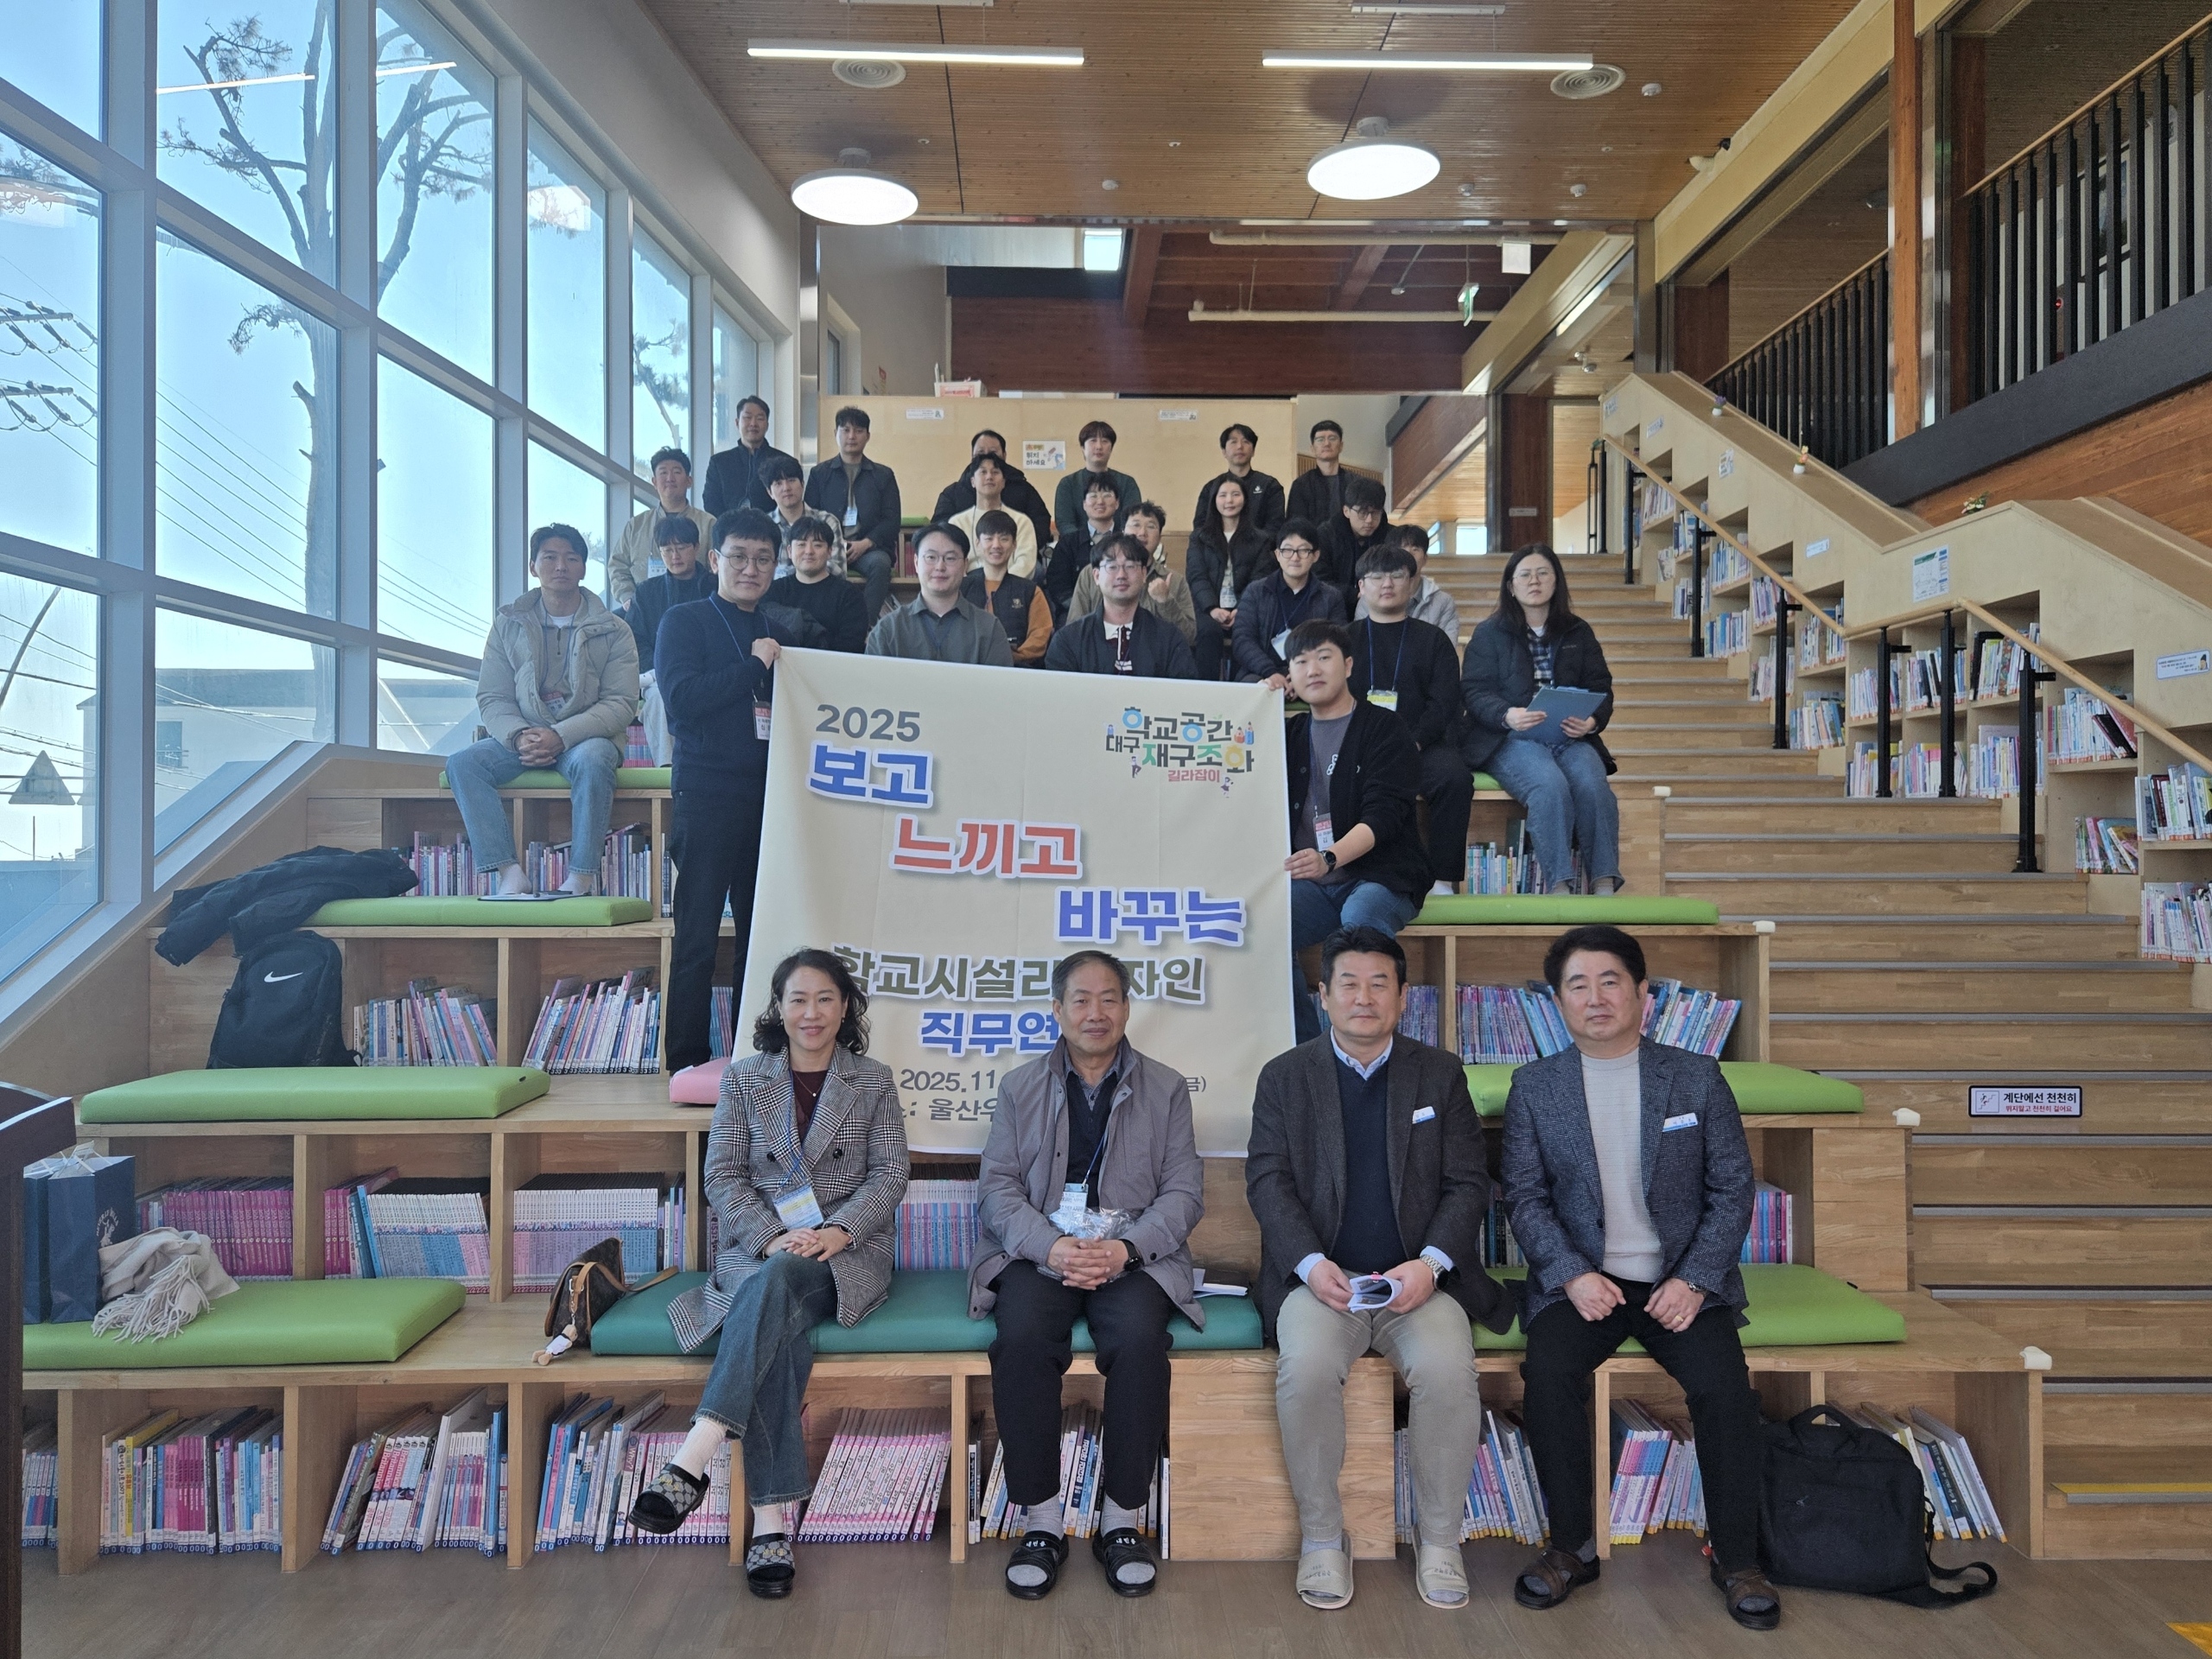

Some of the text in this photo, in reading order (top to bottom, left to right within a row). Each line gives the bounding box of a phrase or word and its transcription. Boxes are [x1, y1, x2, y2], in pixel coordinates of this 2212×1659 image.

[816, 704, 920, 742] 2025
[1122, 707, 1234, 743] 학교공간
[1106, 734, 1140, 753] 대구
[1141, 743, 1255, 773] 재구조화
[809, 743, 930, 804] 보고
[1168, 769, 1220, 782] 길라잡이
[893, 817, 1078, 875] 느끼고
[1058, 890, 1243, 943] 바꾸는
[835, 944, 1203, 1001] 학교시설리자인
[922, 1012, 1062, 1054] 직무연
[899, 1068, 995, 1095] 2025.11
[2004, 1092, 2076, 1103] 계단에선 천천히
[373, 1451, 391, 1491] Britannica
[383, 1450, 401, 1491] Britannica
[392, 1449, 410, 1489] Britannica
[625, 1447, 636, 1470] Why?
